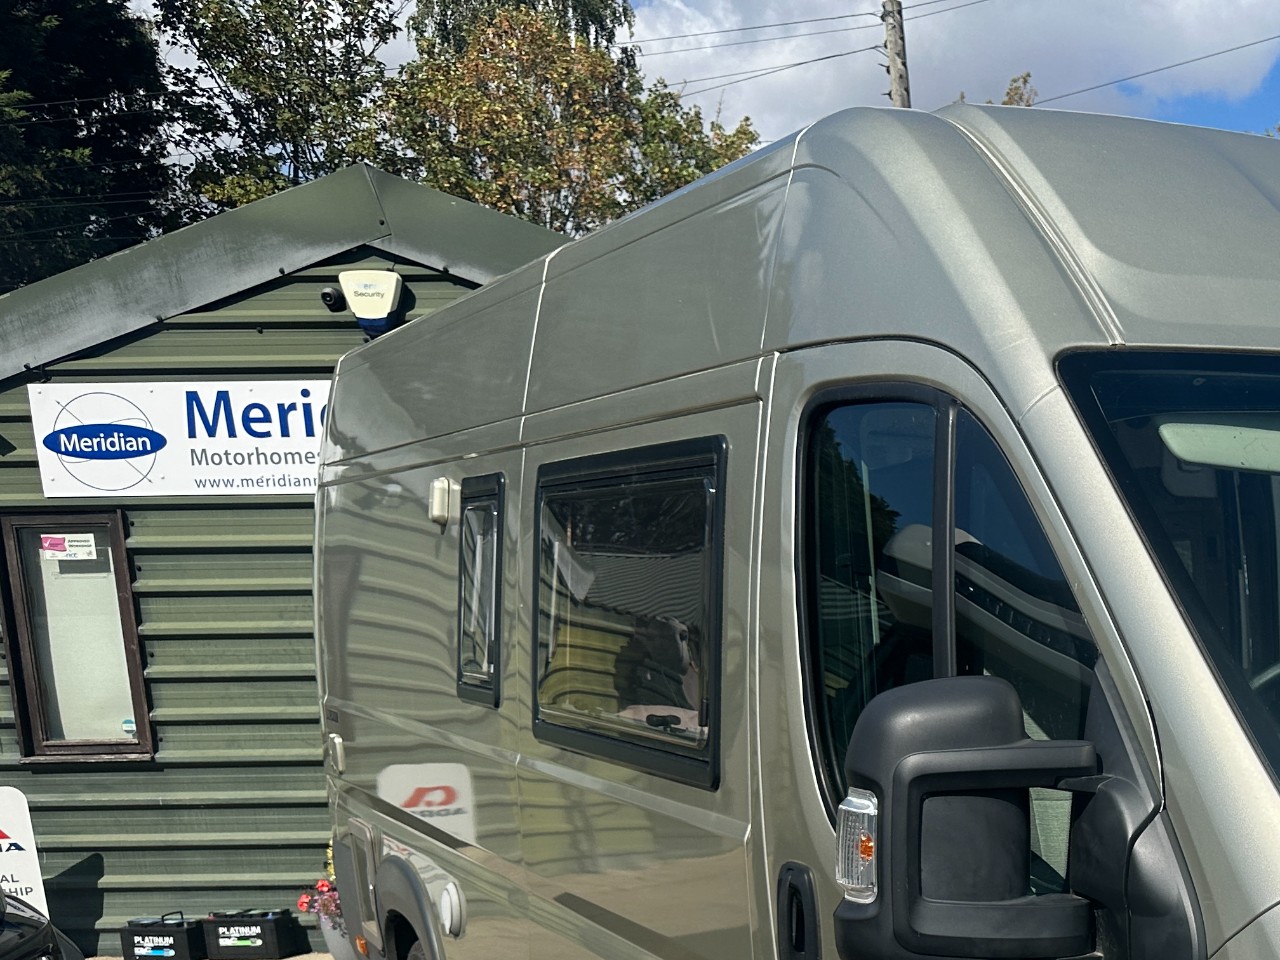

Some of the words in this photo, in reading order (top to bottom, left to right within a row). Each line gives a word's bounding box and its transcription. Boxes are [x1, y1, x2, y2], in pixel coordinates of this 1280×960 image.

[353, 290, 385, 299] Security
[185, 388, 327, 438] Meri
[60, 432, 151, 452] Meridian
[218, 926, 261, 935] PLATINUM
[133, 936, 174, 945] PLATINUM
